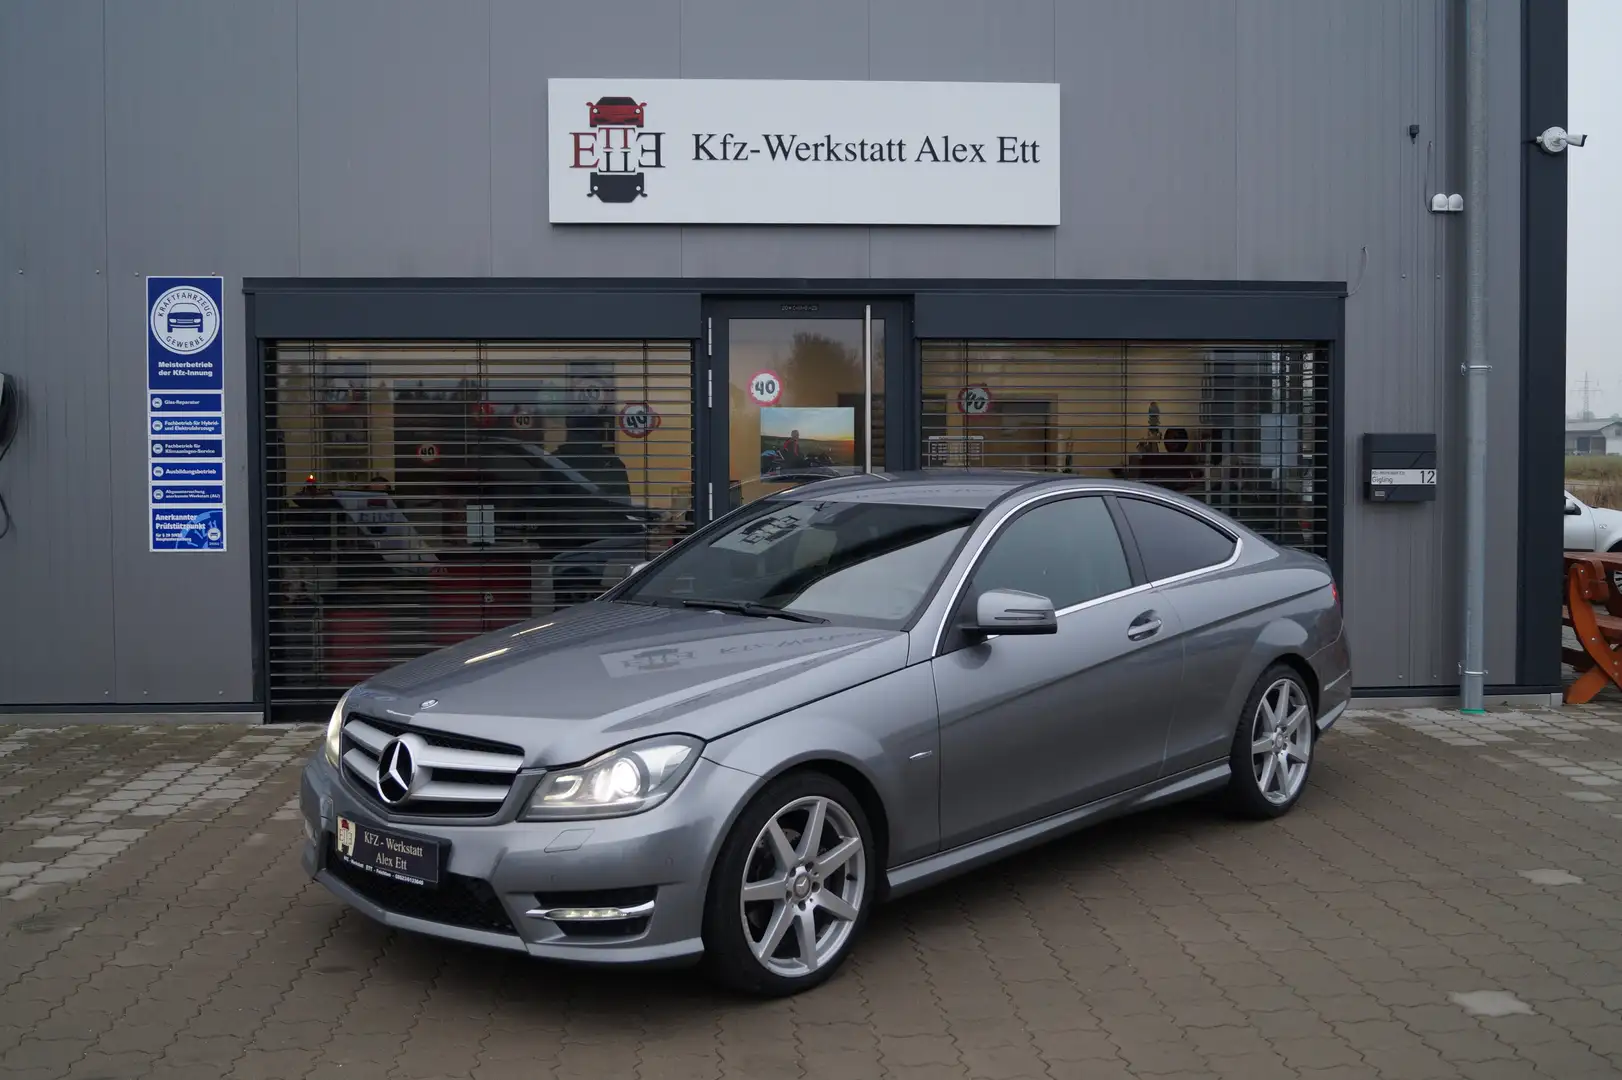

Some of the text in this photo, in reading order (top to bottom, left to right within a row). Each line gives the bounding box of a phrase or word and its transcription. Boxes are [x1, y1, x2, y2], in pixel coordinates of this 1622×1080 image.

[692, 133, 1041, 163] Kfz-Werkstatt Alex Ett
[158, 292, 213, 317] KRAFTFAHRZEUG
[166, 335, 204, 348] GEWERBE
[755, 379, 776, 395] 40
[1372, 470, 1435, 484] Gigling 12
[155, 522, 206, 530] Prüfstützpunkt
[364, 831, 380, 847] KFZ
[385, 837, 423, 857] Werkstatt
[376, 852, 393, 868] Alex
[395, 857, 407, 871] Ett
